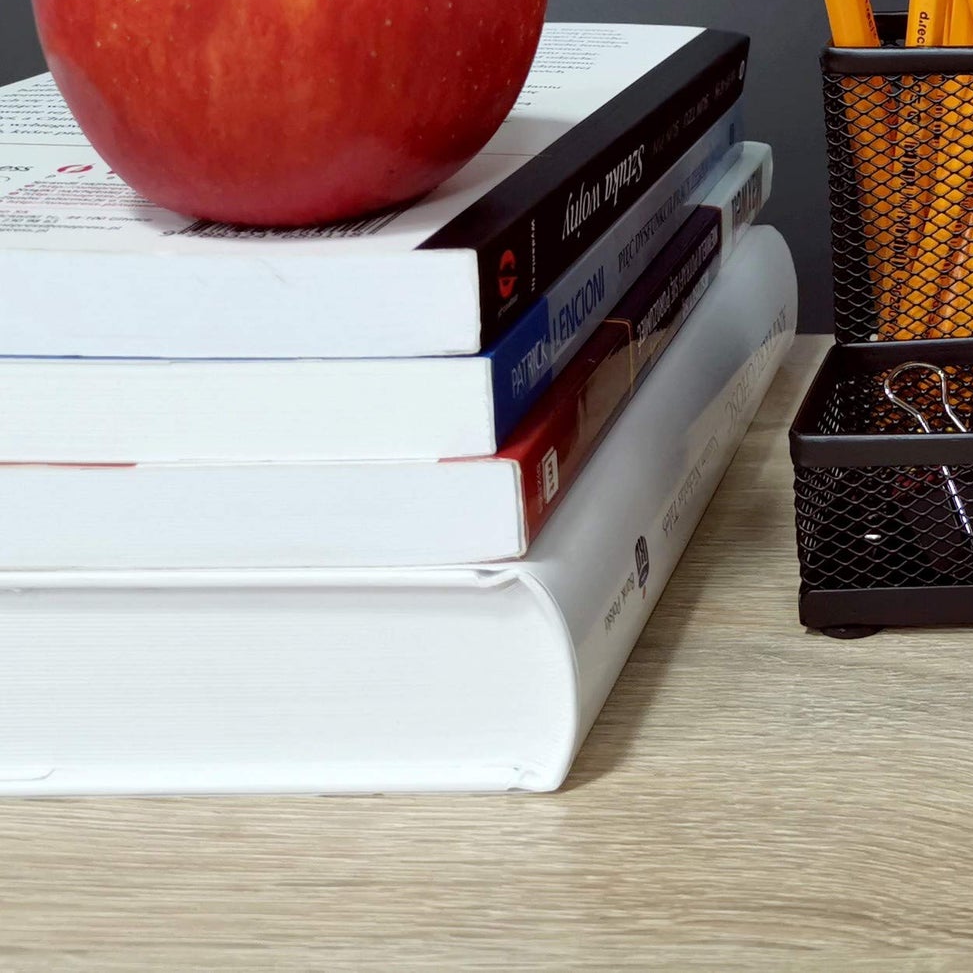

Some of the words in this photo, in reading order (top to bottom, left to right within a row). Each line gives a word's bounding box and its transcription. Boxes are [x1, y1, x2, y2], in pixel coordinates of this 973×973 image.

[605, 144, 645, 207] Sztuka
[562, 181, 601, 241] wojny
[511, 334, 549, 398] PATRICK
[551, 266, 605, 353] LENCIONI
